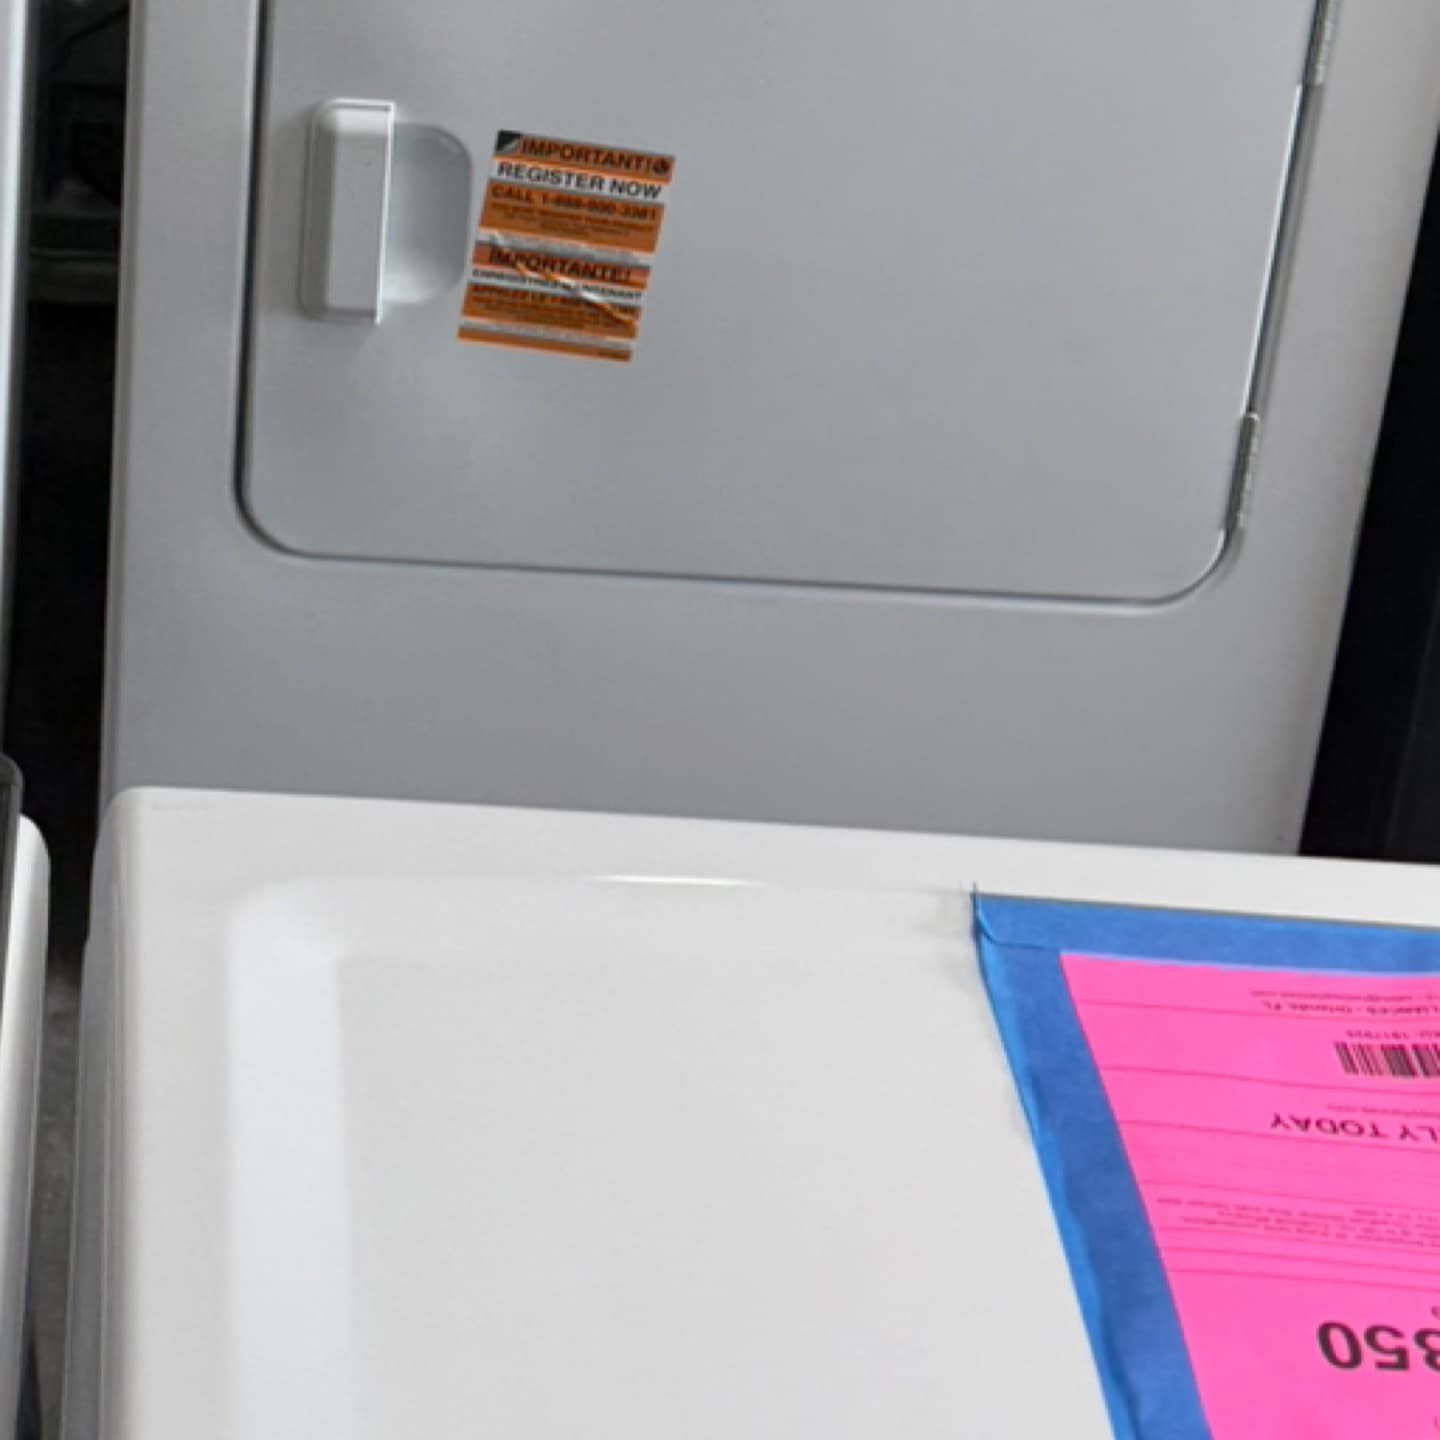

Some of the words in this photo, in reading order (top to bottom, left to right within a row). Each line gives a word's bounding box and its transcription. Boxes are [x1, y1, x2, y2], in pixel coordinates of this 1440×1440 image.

[490, 183, 534, 203] CALL
[497, 161, 605, 191] REGISTER
[609, 177, 662, 200] NOW
[1270, 1112, 1388, 1139] TODAY
